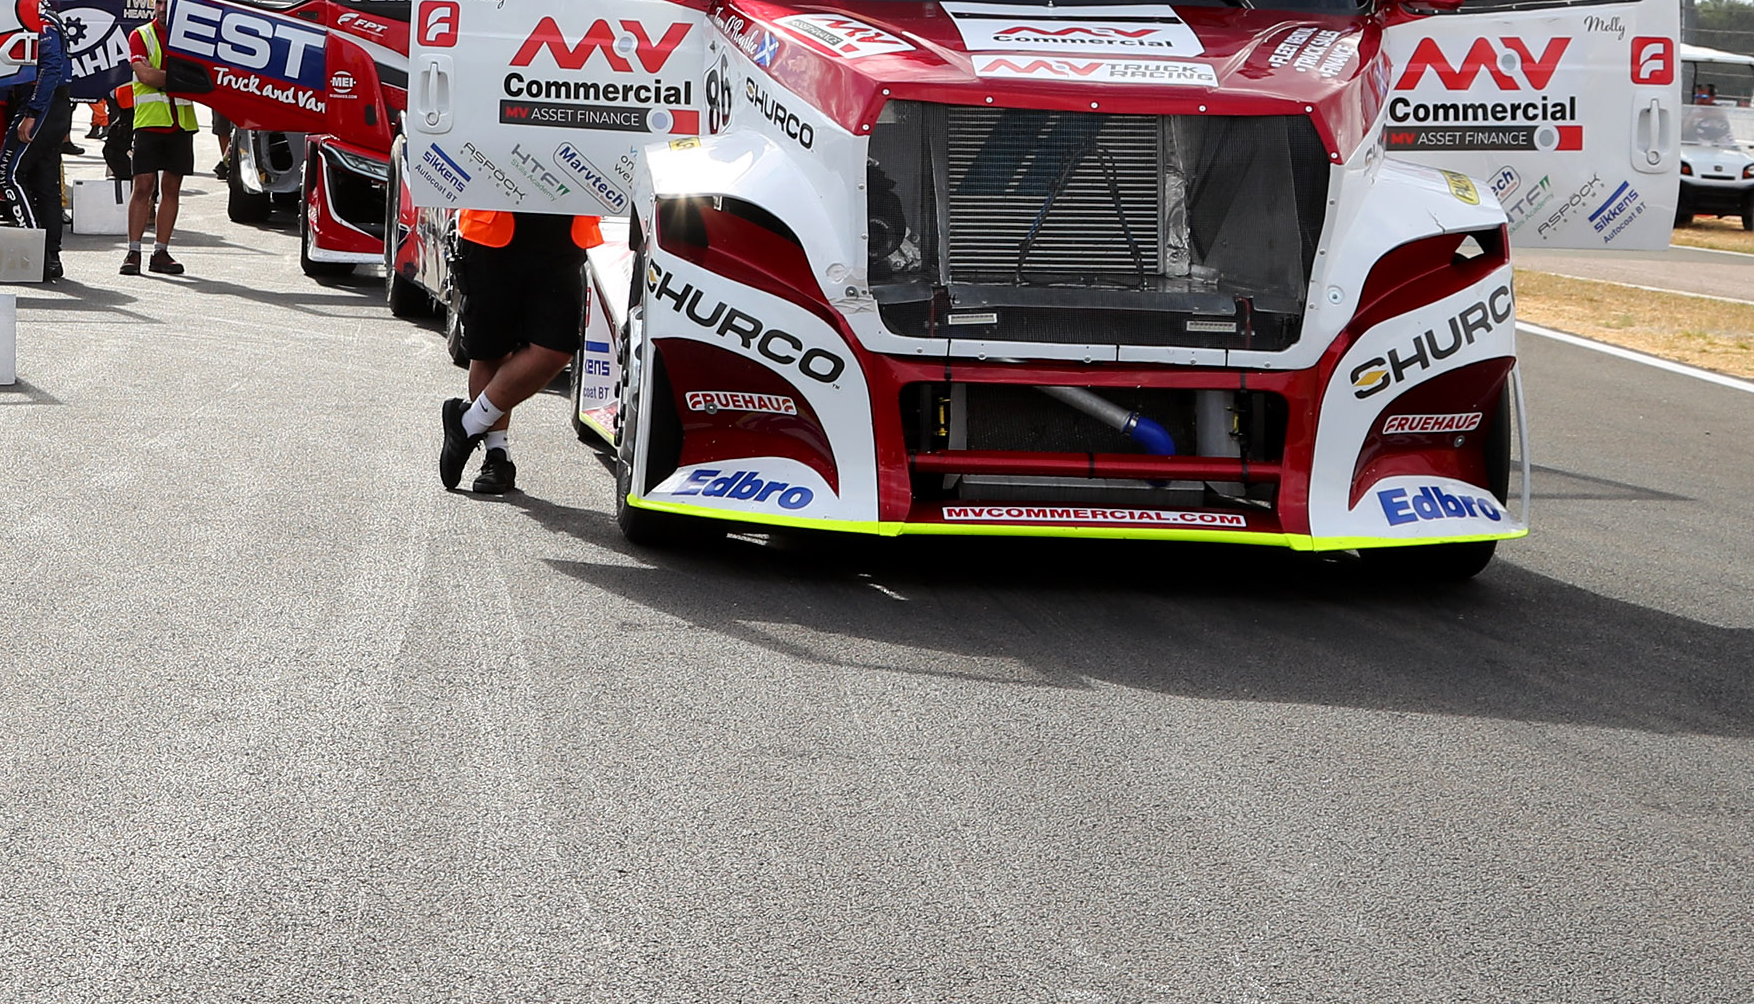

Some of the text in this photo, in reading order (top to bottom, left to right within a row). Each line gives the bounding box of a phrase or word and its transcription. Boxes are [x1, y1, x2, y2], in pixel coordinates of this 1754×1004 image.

[993, 34, 1174, 47] Commercial
[1583, 15, 1626, 41] Molly
[332, 76, 354, 87] MEI
[1106, 63, 1199, 73] TRUCK
[1109, 70, 1214, 81] RACING
[213, 66, 325, 113] Truck and Van
[504, 72, 692, 106] Commercial
[505, 106, 640, 127] MV ASSET FINANCE
[746, 76, 814, 150] SHURCO
[1389, 96, 1576, 122] Commercial
[1390, 132, 1528, 145] MV ASSET FINANCE
[422, 151, 466, 193] sikkens
[511, 143, 560, 187] HTF
[559, 146, 624, 207] Marvtech
[415, 164, 458, 203] Autocoat BT
[527, 174, 557, 202] Academy
[1594, 189, 1639, 233] sikkens
[1603, 202, 1647, 244] Autocoat BT
[1350, 276, 1515, 400] SHURC
[1384, 414, 1481, 433] FRUEHAUF
[672, 469, 814, 510] Edbro
[1377, 486, 1502, 526] Edbro
[947, 507, 1243, 525] MVCOMMERCIAL.COM
